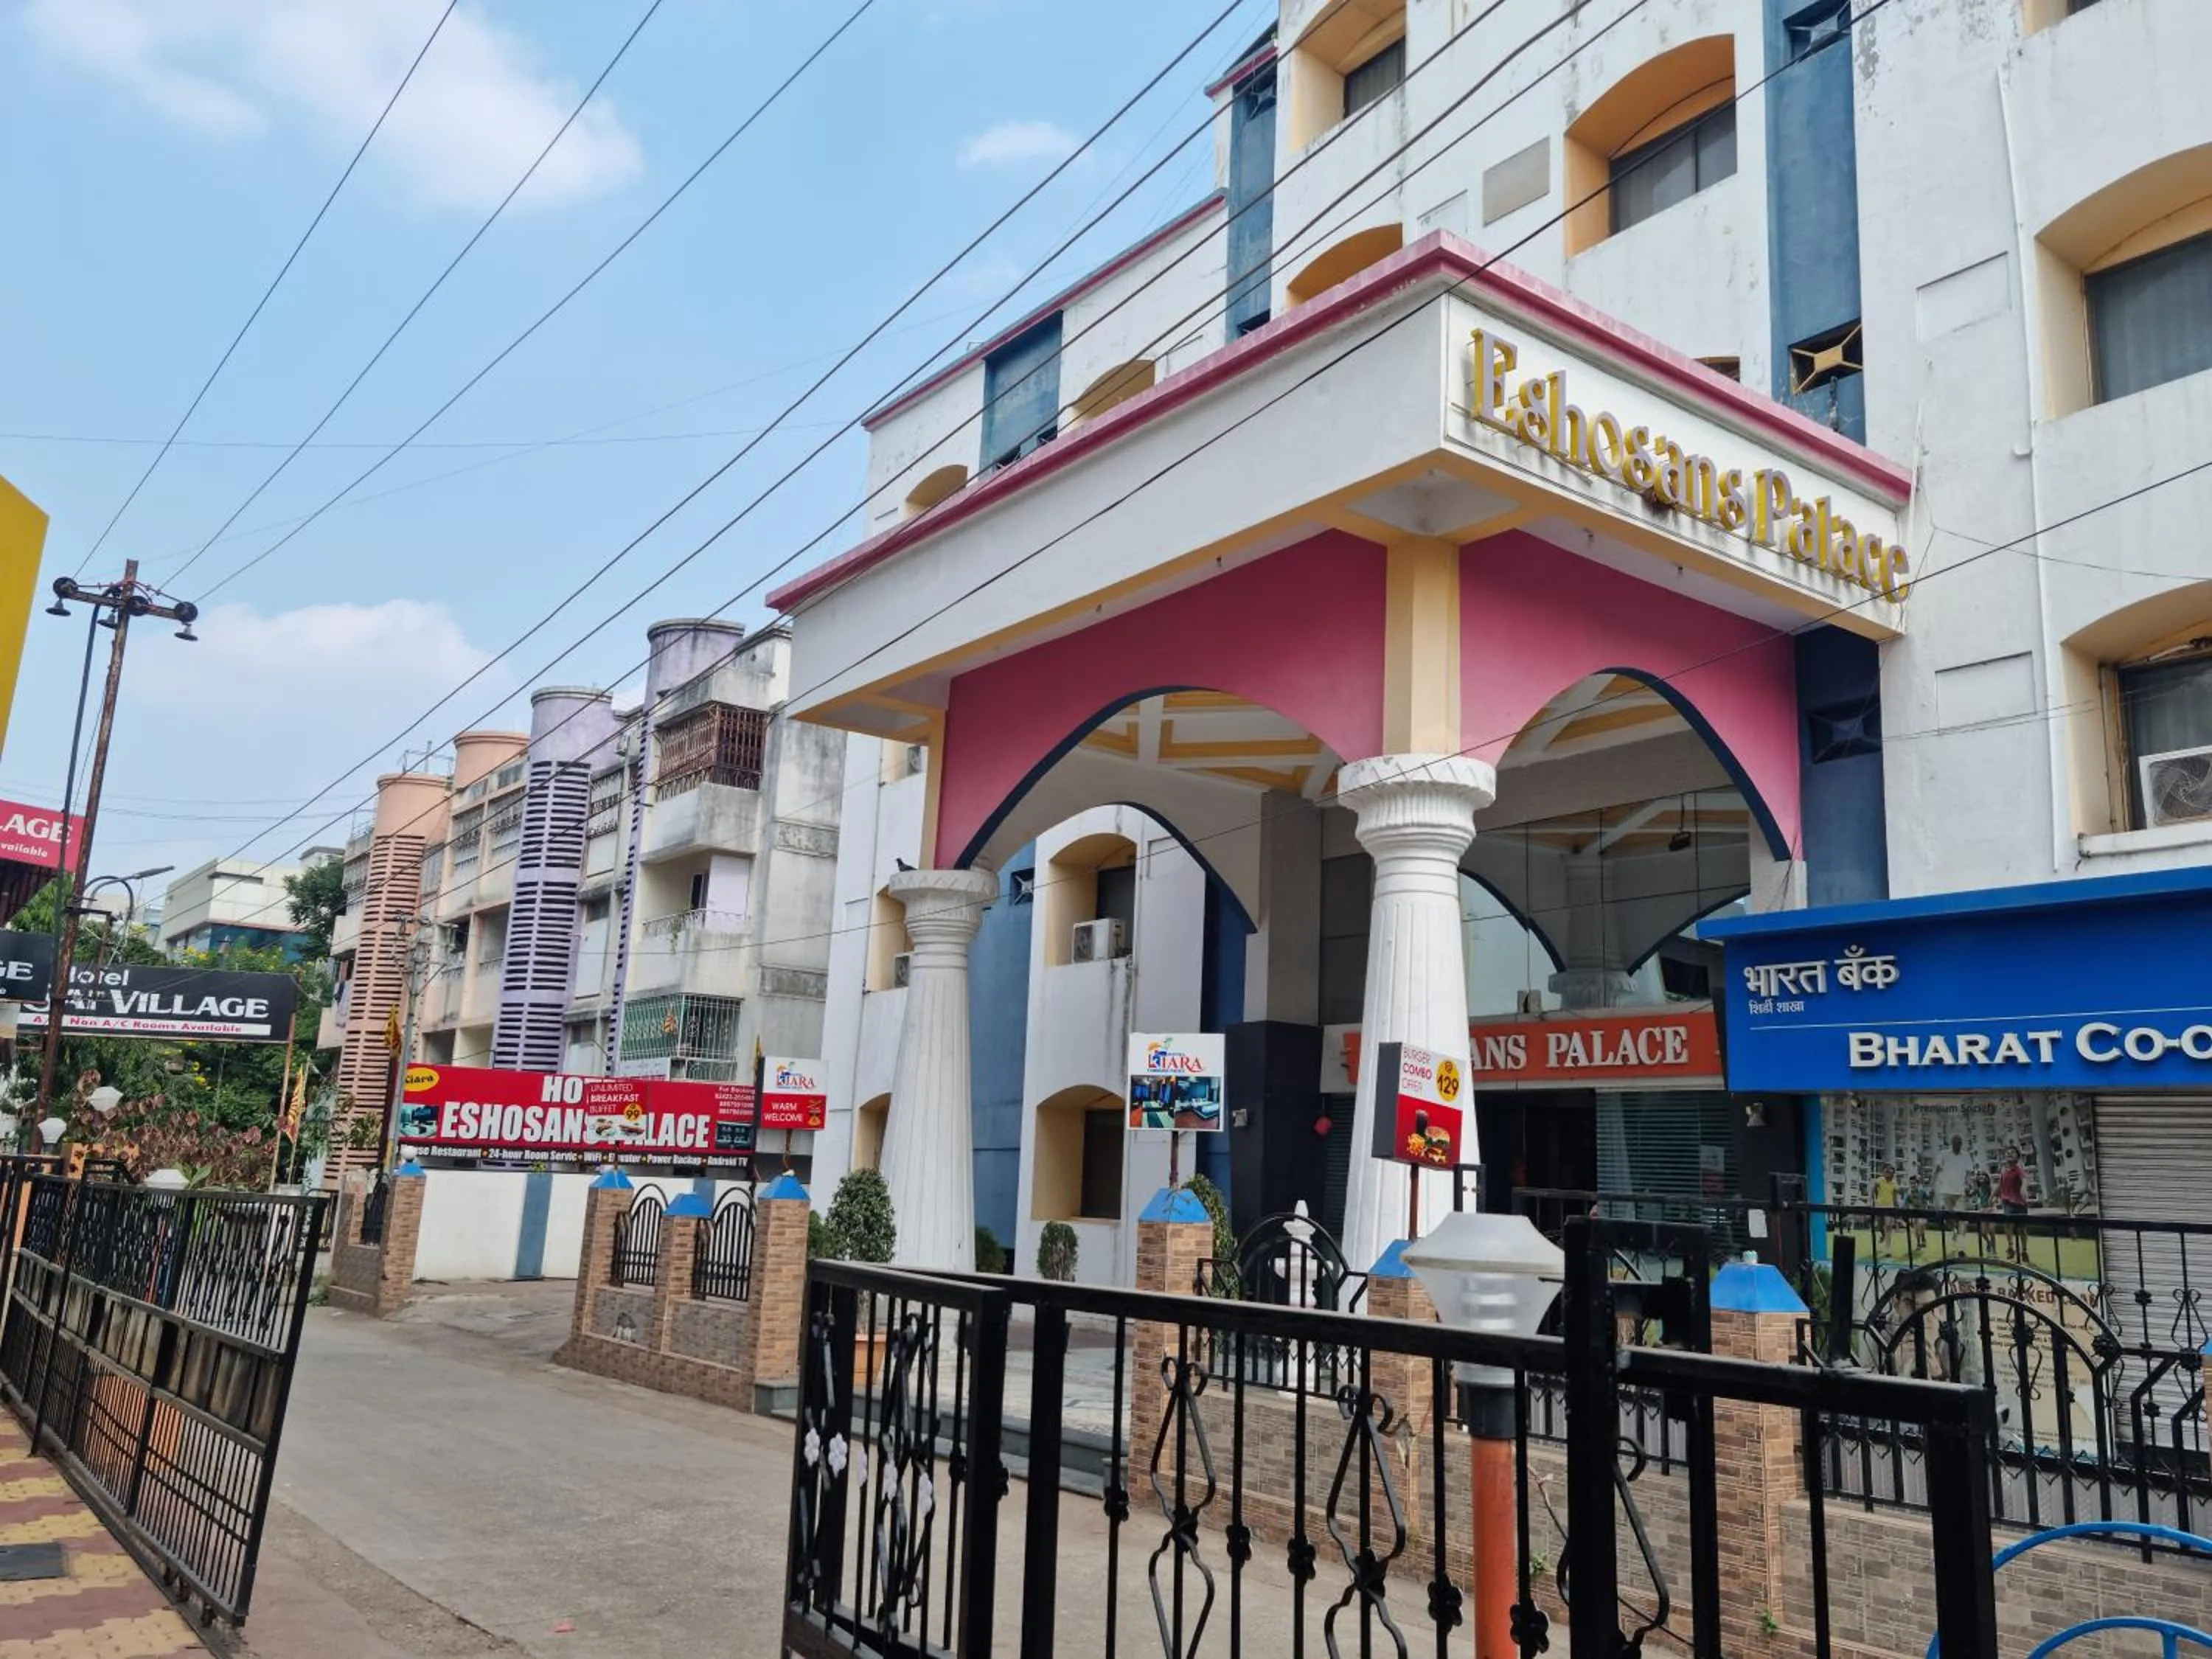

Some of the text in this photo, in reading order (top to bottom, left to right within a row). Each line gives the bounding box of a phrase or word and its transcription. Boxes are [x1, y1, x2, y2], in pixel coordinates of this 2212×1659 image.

[1470, 327, 1909, 604] Eshosans Palace
[0, 813, 73, 844] AGE
[1, 843, 48, 858] vailable
[1743, 960, 1829, 997] भारत
[109, 989, 269, 1018] VILLAGE
[1546, 1026, 1689, 1068] PALACE
[1848, 1029, 2062, 1068] BHARAT
[1402, 1062, 1433, 1079] COMBO
[591, 1083, 633, 1092] UNLIMITED
[1437, 1074, 1459, 1096] 129
[591, 1093, 639, 1102] BREAKFAST
[771, 1102, 797, 1111] WARM
[589, 1104, 616, 1114] BUFFET
[626, 1109, 641, 1119] 99
[763, 1113, 804, 1122] WELCOME
[608, 1112, 711, 1148] LACE
[431, 1145, 481, 1158] Restaurant
[489, 1150, 522, 1160] 24-hour
[524, 1150, 549, 1161] Room
[647, 1154, 672, 1164] Power
[708, 1155, 737, 1166] Android
[738, 1157, 748, 1166] TV
